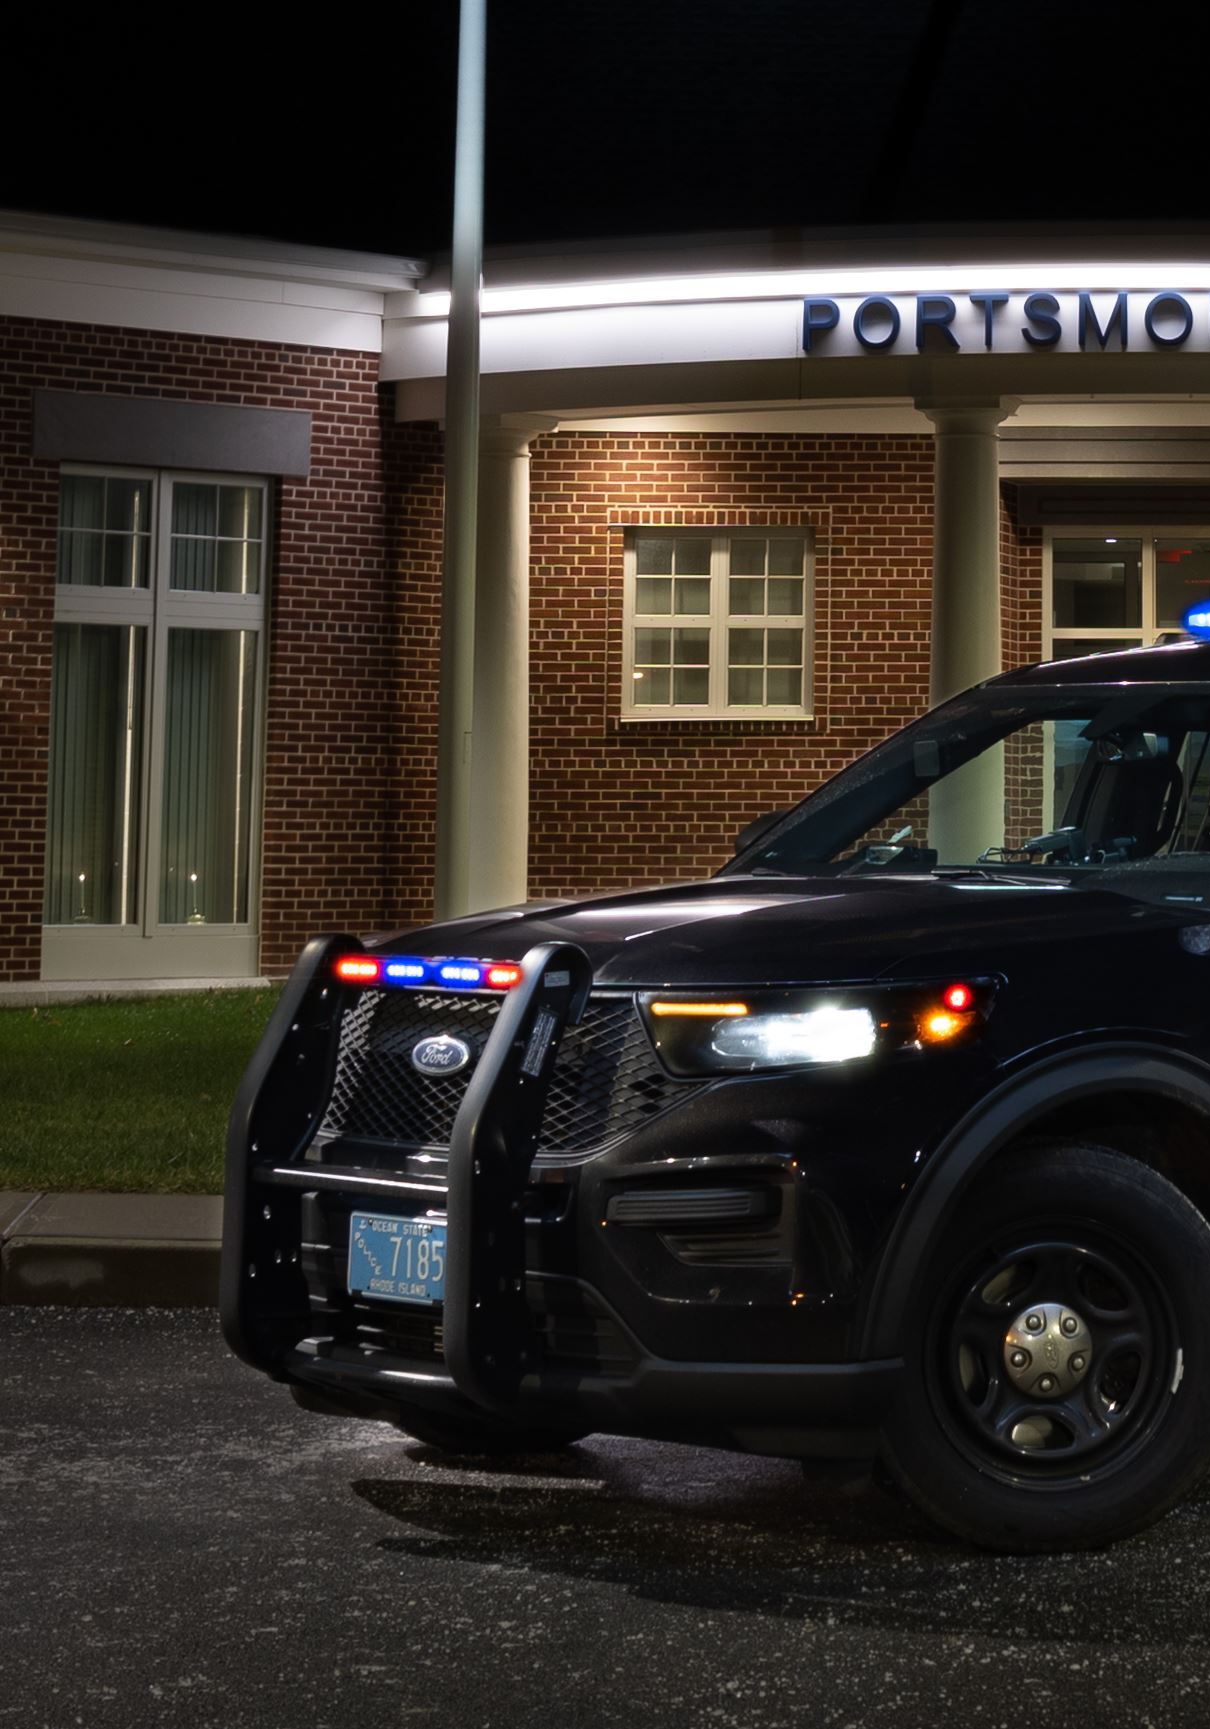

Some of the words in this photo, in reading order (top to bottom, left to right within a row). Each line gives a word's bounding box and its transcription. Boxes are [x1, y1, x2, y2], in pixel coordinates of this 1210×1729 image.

[421, 1044, 453, 1065] Ford
[372, 1220, 398, 1233] OCEAN
[403, 1224, 428, 1237] STATE
[354, 1232, 382, 1275] POLICE
[390, 1236, 444, 1282] 7185
[370, 1279, 395, 1293] RHODE
[399, 1282, 426, 1297] ISLAND
